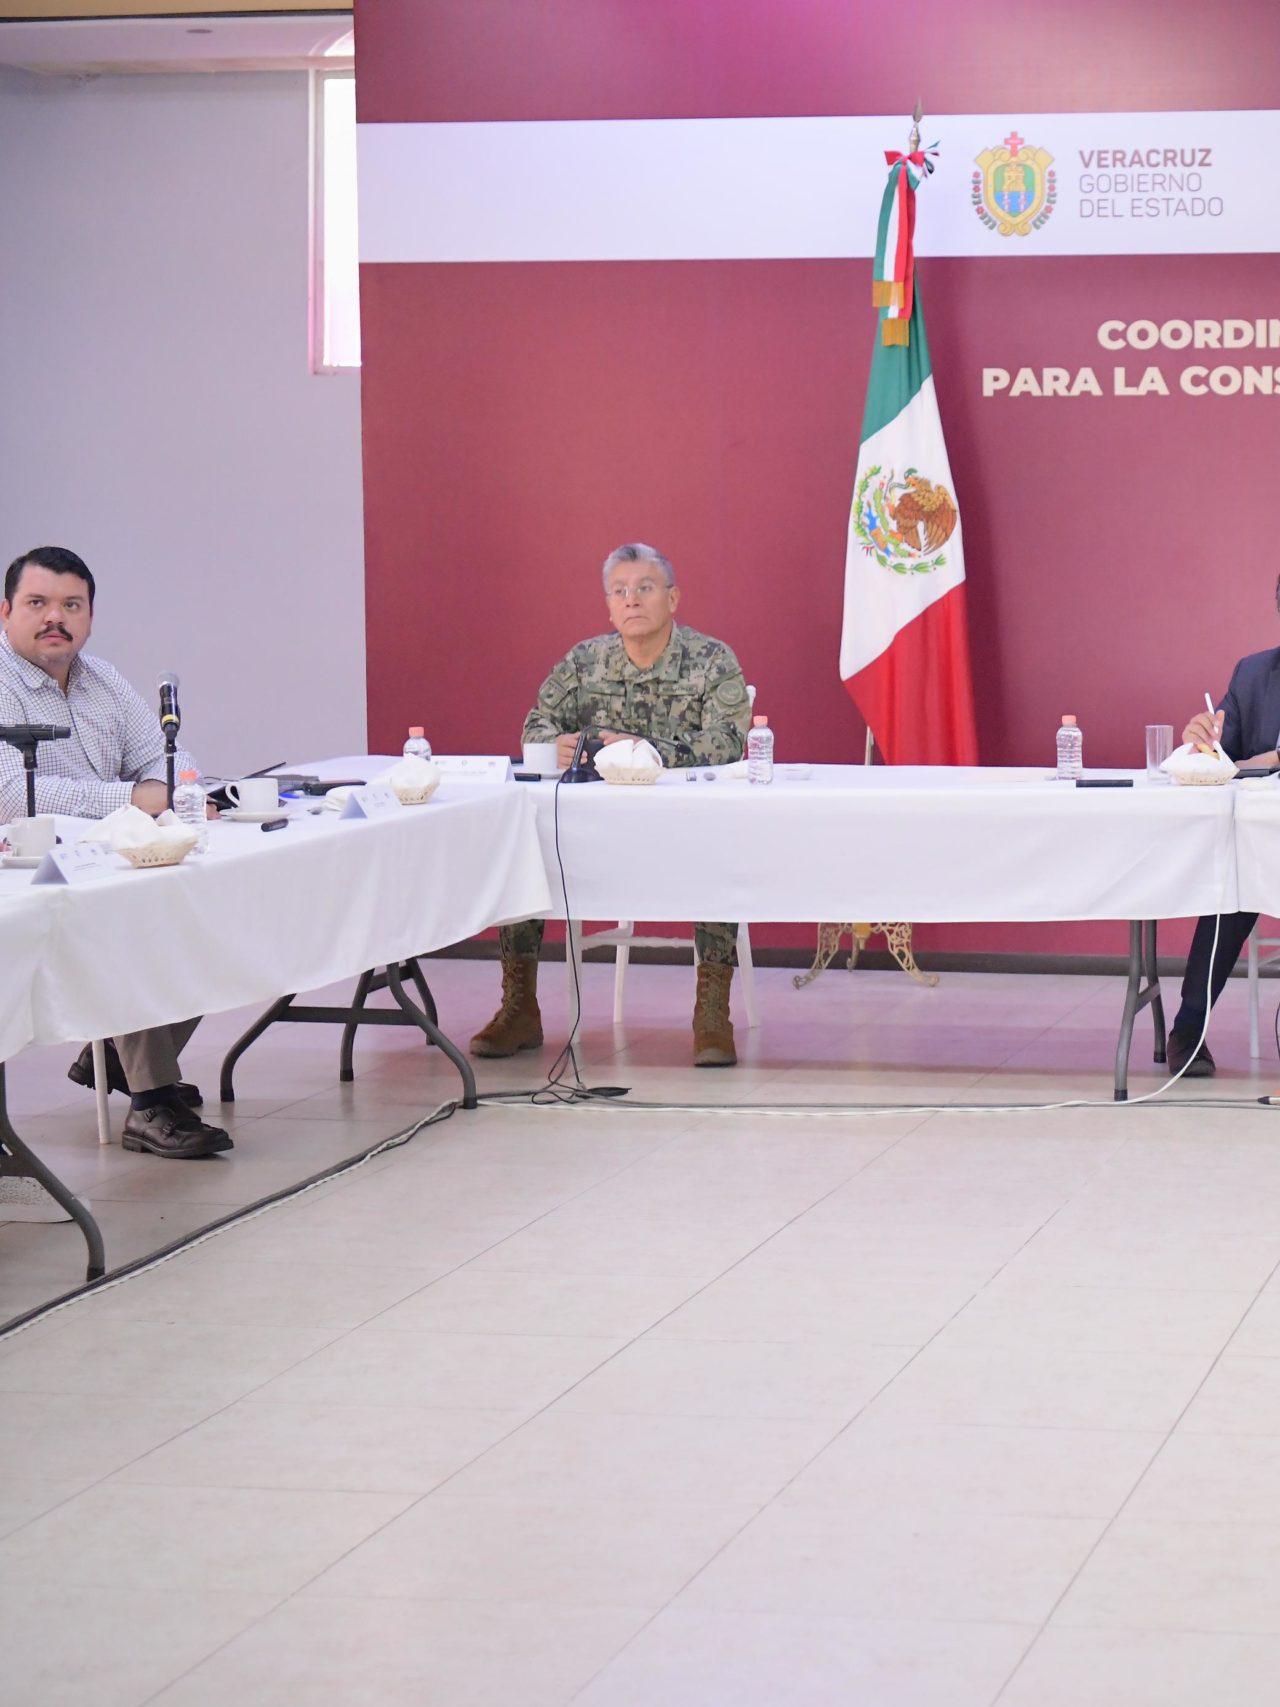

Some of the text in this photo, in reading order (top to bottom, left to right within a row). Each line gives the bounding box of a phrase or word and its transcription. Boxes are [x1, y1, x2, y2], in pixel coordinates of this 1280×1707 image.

[1079, 148, 1213, 169] VERACRUZ
[1079, 172, 1202, 194] GOBIERNO
[1079, 196, 1224, 218] DEL ESTADO
[982, 366, 1103, 397] PARA
[1114, 366, 1170, 396] LA
